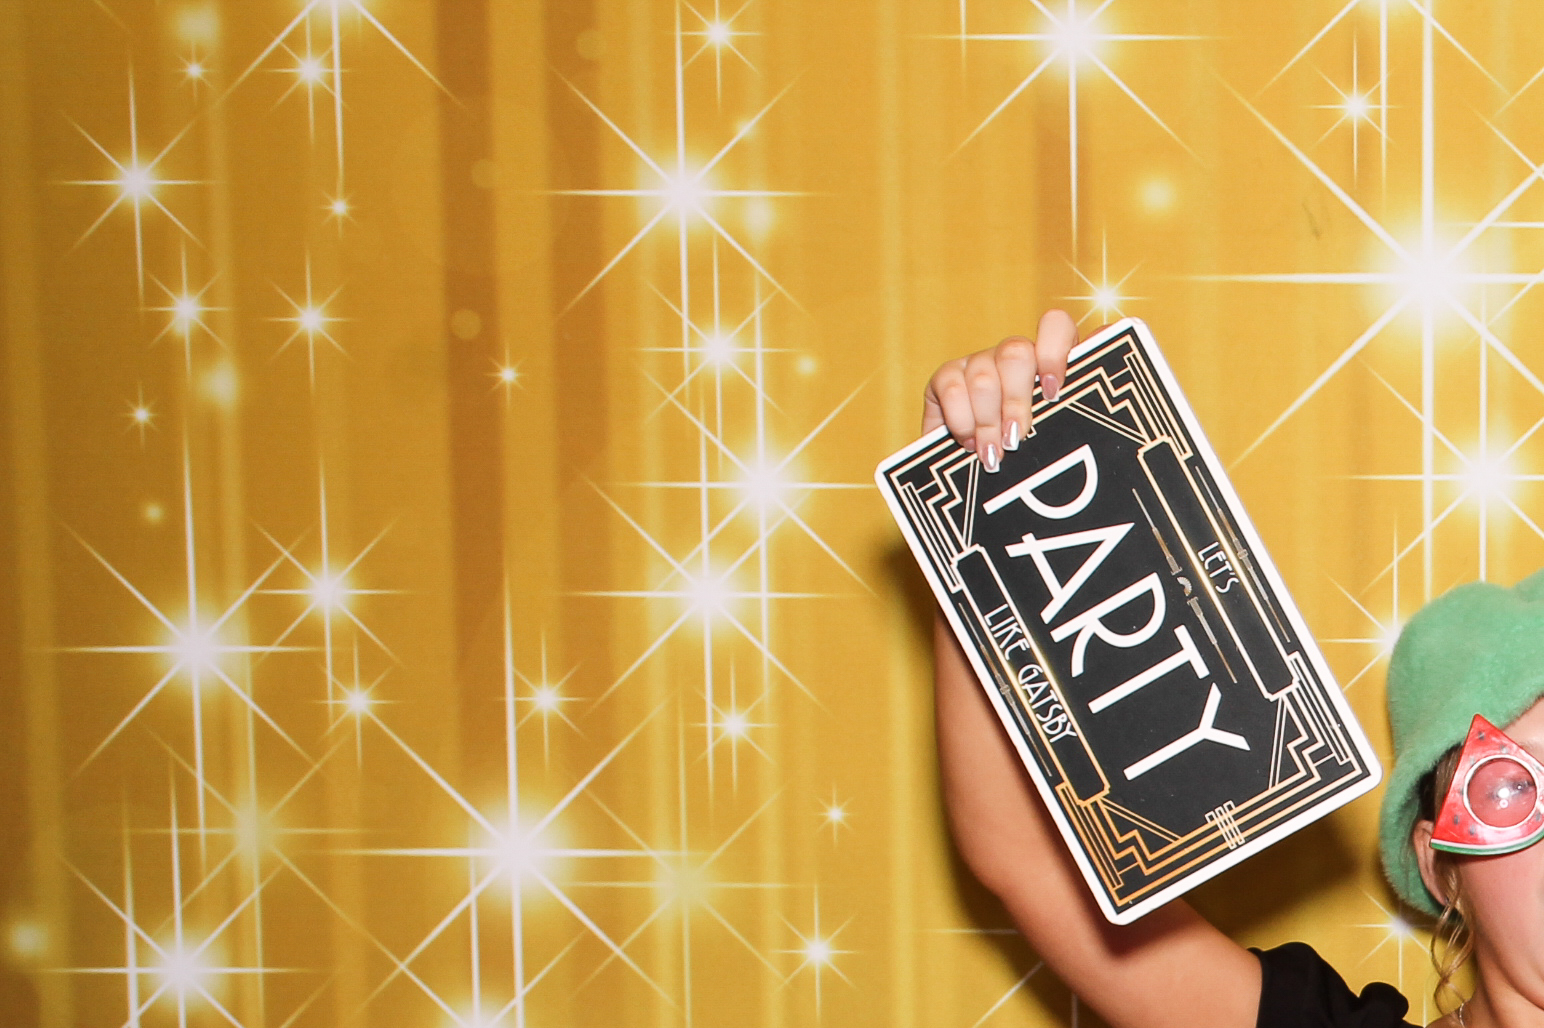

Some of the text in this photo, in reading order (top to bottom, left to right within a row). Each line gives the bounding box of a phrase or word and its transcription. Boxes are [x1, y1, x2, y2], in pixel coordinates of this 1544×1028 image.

[982, 443, 1251, 782] PARTY
[1196, 541, 1239, 594] LET'S
[984, 603, 1078, 743] LIKE GATSBY
